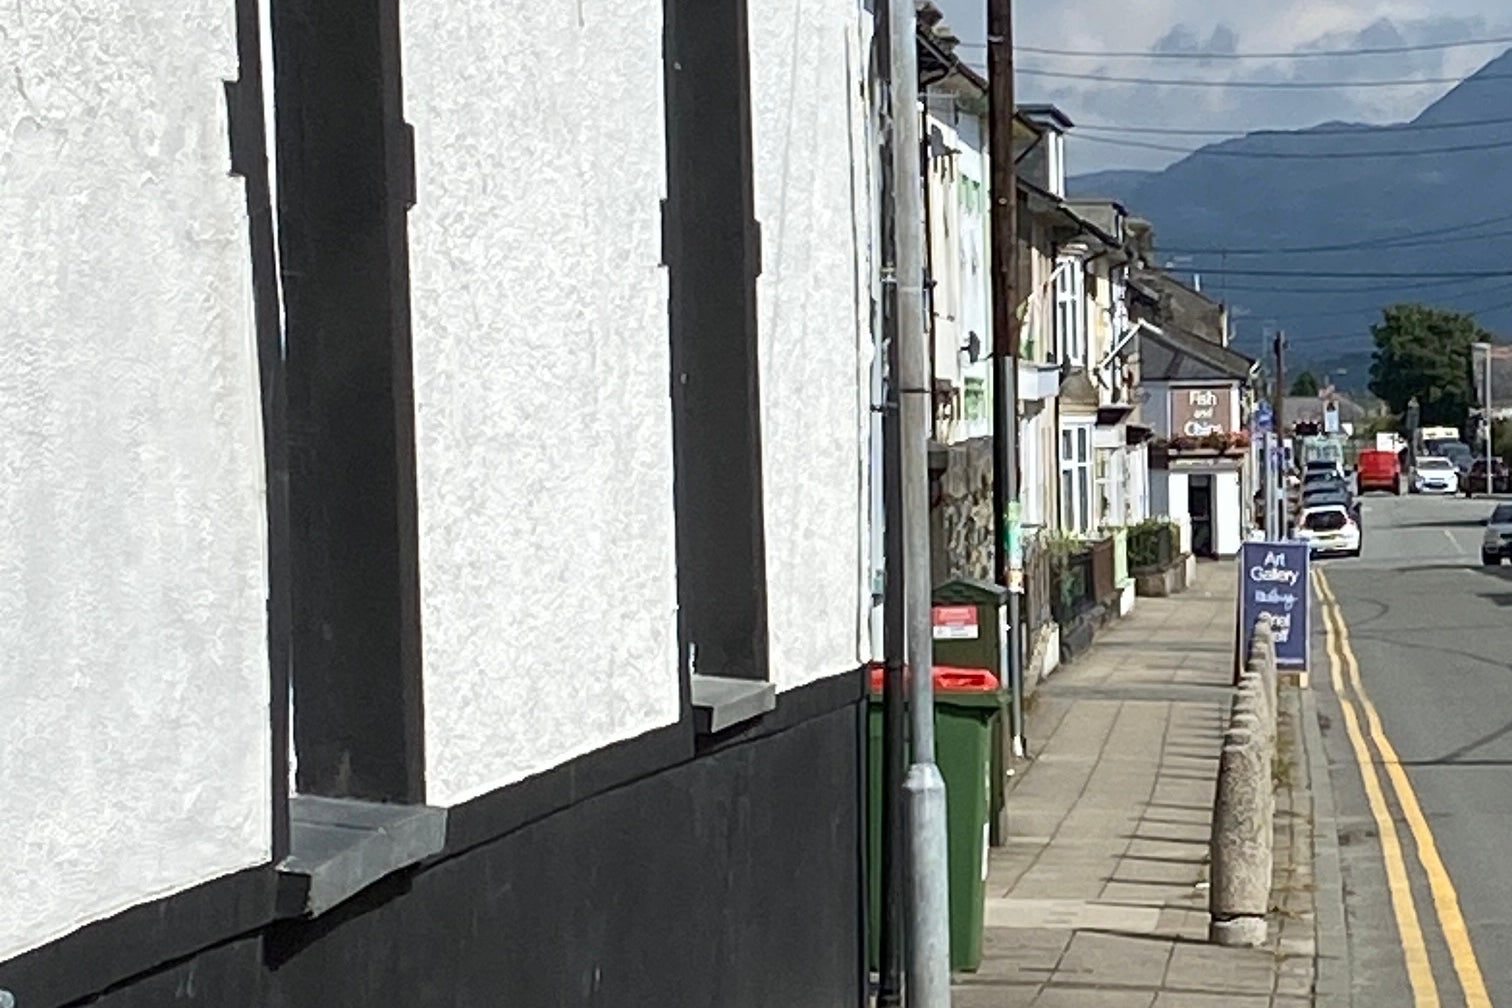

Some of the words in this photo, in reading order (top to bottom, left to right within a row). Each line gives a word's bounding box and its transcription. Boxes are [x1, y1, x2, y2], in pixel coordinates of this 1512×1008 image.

[1189, 390, 1218, 406] Fish
[1264, 550, 1286, 568] Art
[1250, 565, 1300, 587] Gallery
